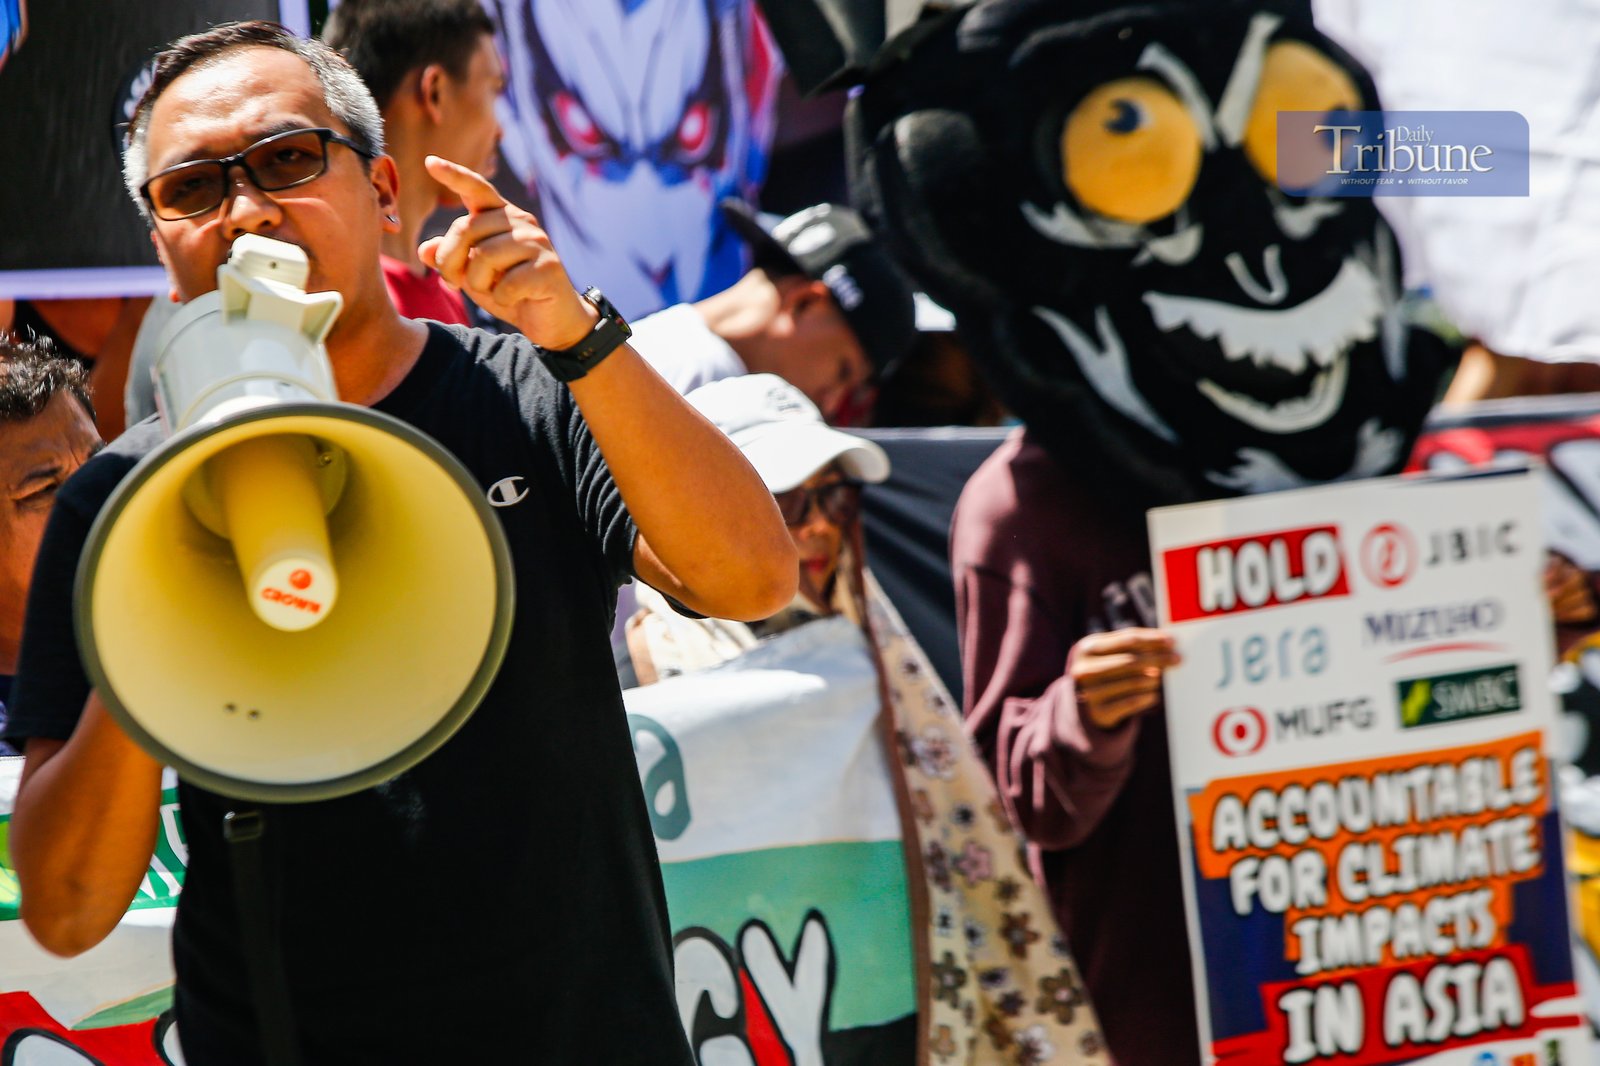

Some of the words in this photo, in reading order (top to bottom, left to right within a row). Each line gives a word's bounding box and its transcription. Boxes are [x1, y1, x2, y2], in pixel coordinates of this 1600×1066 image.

[1198, 530, 1341, 612] HOLD
[1426, 521, 1518, 566] JBIC
[261, 587, 321, 614] CROWN
[1276, 698, 1375, 742] MUFG
[1212, 748, 1542, 851] ACCOUNTABLE
[1229, 848, 1328, 914] FOR
[1336, 815, 1541, 903] CLIMATE
[1291, 888, 1496, 975] IMPACTS
[1278, 981, 1364, 1064] IN
[1383, 957, 1525, 1046] ASIA
